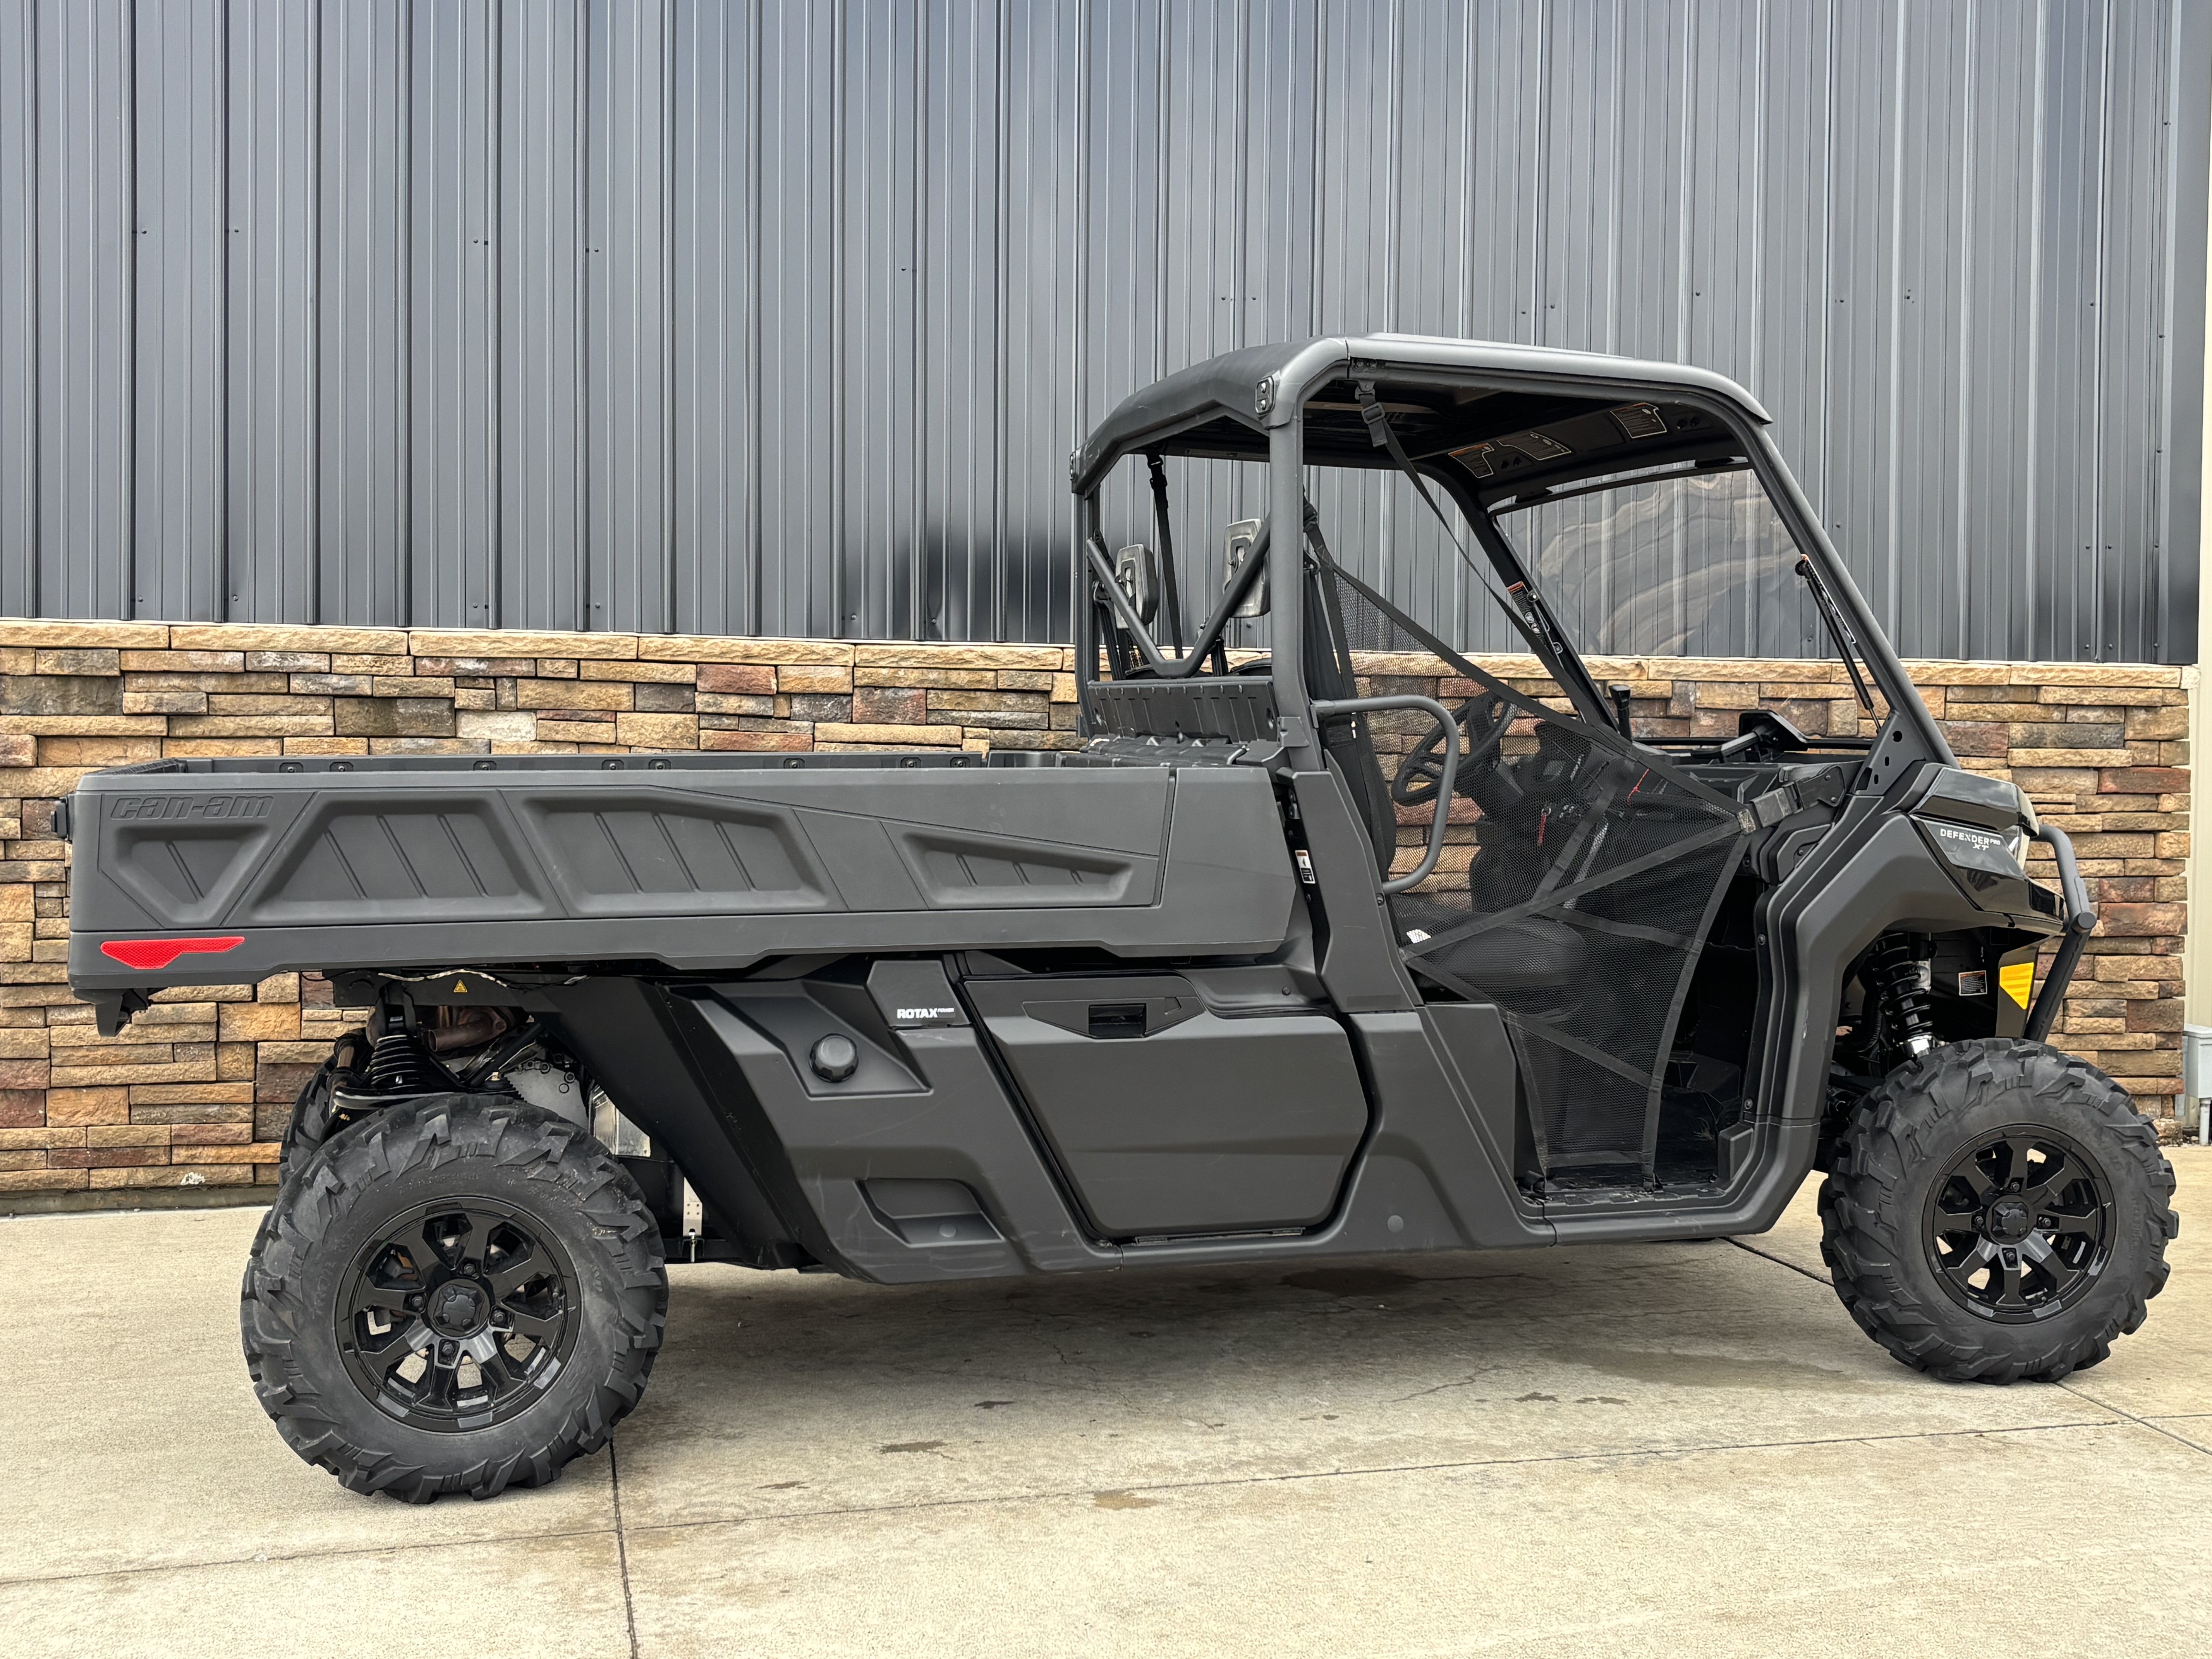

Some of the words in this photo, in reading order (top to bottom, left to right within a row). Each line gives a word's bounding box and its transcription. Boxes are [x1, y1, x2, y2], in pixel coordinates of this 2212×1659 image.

[110, 796, 274, 820] can-am
[1940, 828, 1990, 845] DEFENDER
[1972, 843, 1989, 851] XT
[896, 1008, 938, 1019] ROTAX
